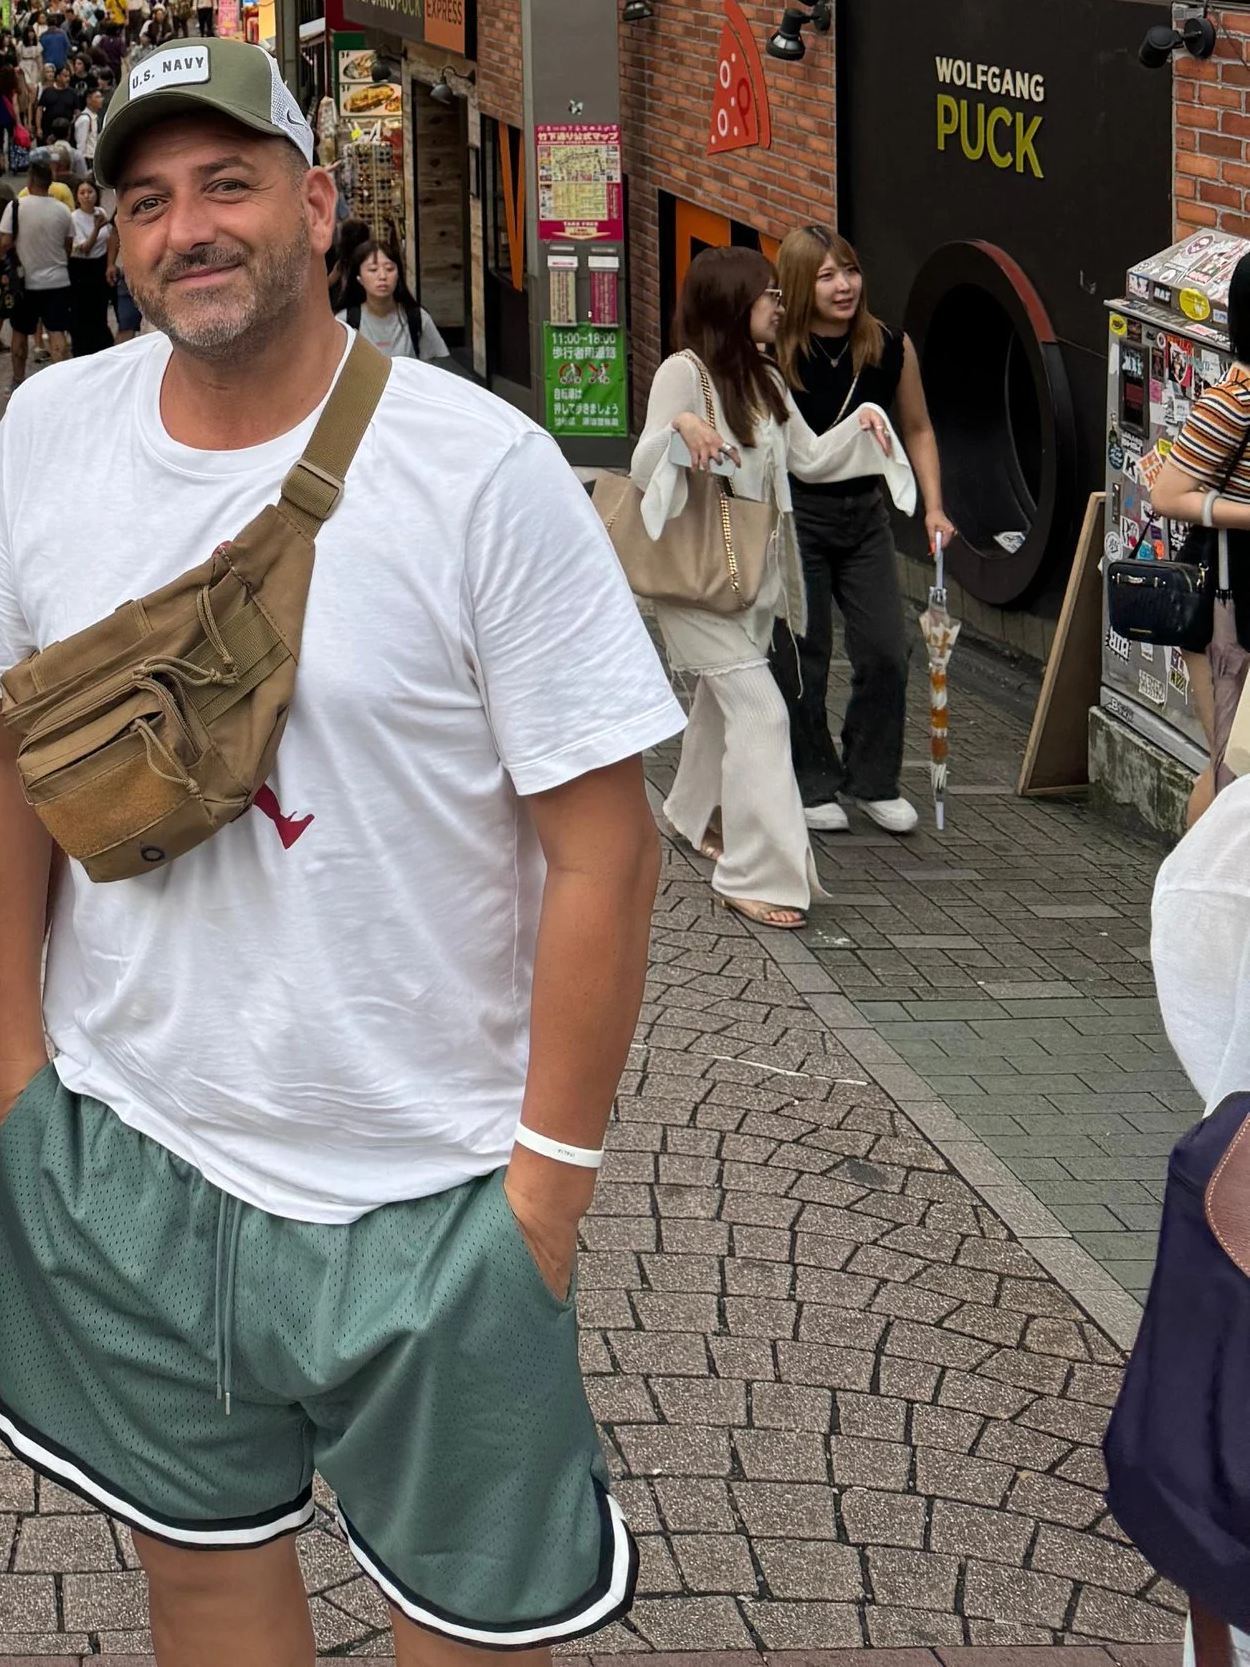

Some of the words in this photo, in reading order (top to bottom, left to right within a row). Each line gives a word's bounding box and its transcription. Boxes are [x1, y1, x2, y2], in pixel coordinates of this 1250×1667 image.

[132, 70, 155, 90] U.S.
[162, 57, 204, 74] NAVY
[935, 56, 1045, 102] WOLFGANG
[937, 94, 1045, 179] PUCK
